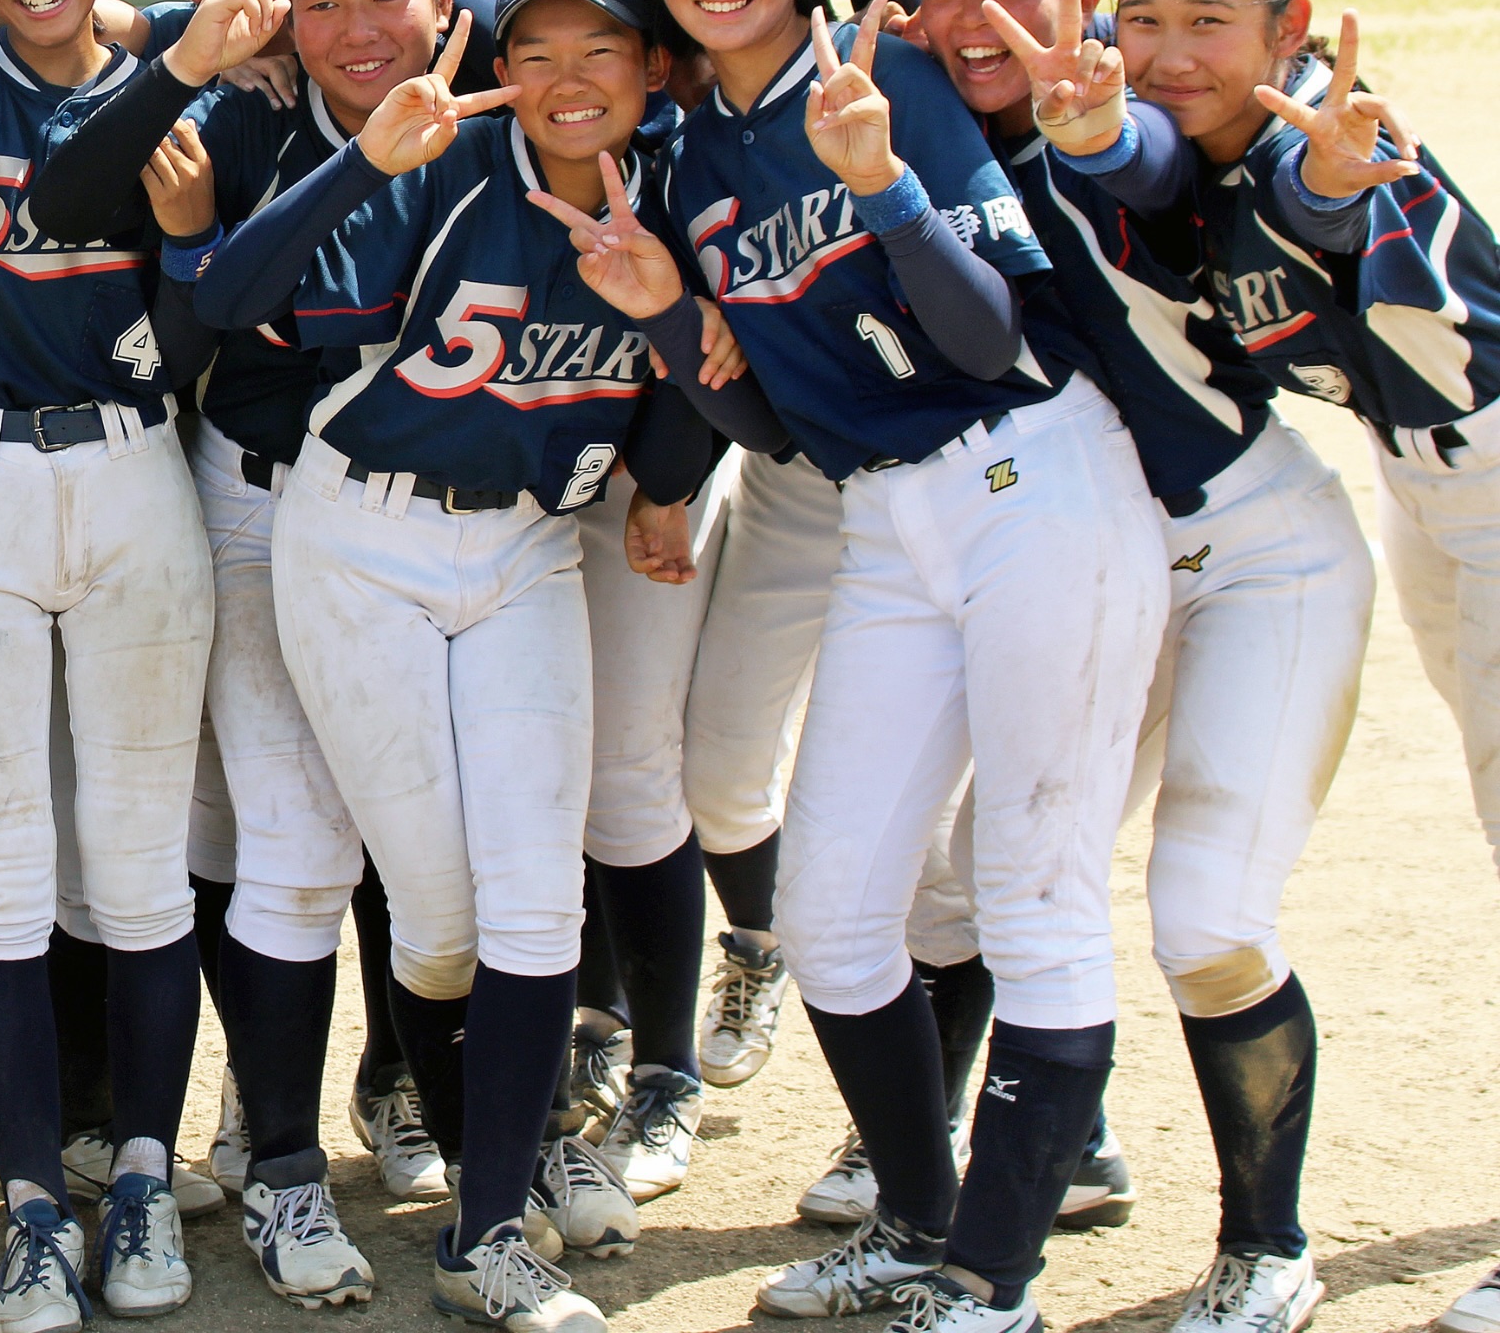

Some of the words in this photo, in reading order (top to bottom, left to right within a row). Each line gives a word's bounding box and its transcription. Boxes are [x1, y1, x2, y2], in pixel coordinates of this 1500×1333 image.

[112, 312, 162, 381] 4
[395, 281, 650, 399] 5STAR
[856, 313, 916, 379] 1
[558, 444, 617, 510] 2
